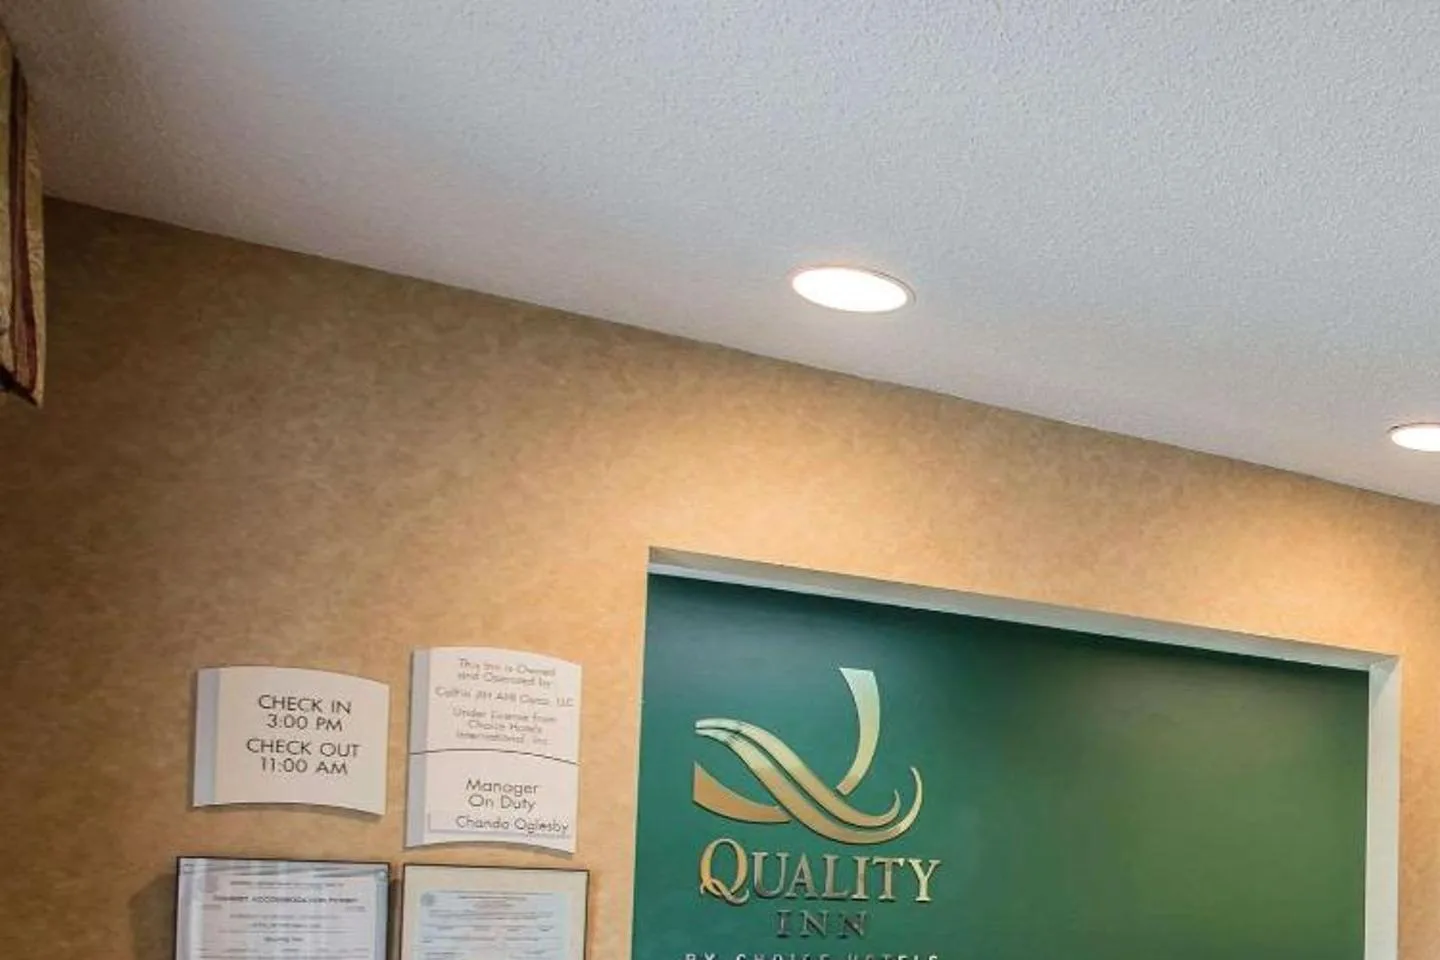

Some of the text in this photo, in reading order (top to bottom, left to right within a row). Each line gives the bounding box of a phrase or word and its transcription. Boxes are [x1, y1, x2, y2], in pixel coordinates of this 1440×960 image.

[258, 694, 351, 714] CHECK IN
[266, 713, 342, 731] 3:00 PM
[246, 738, 361, 758] CHECK OUT
[260, 756, 348, 774] 11:00 AM
[466, 779, 539, 797] Manager
[468, 794, 536, 813] On Duty
[456, 816, 569, 834] Chanda Oglesby
[699, 838, 941, 907] QUALITY
[776, 910, 868, 938] INN
